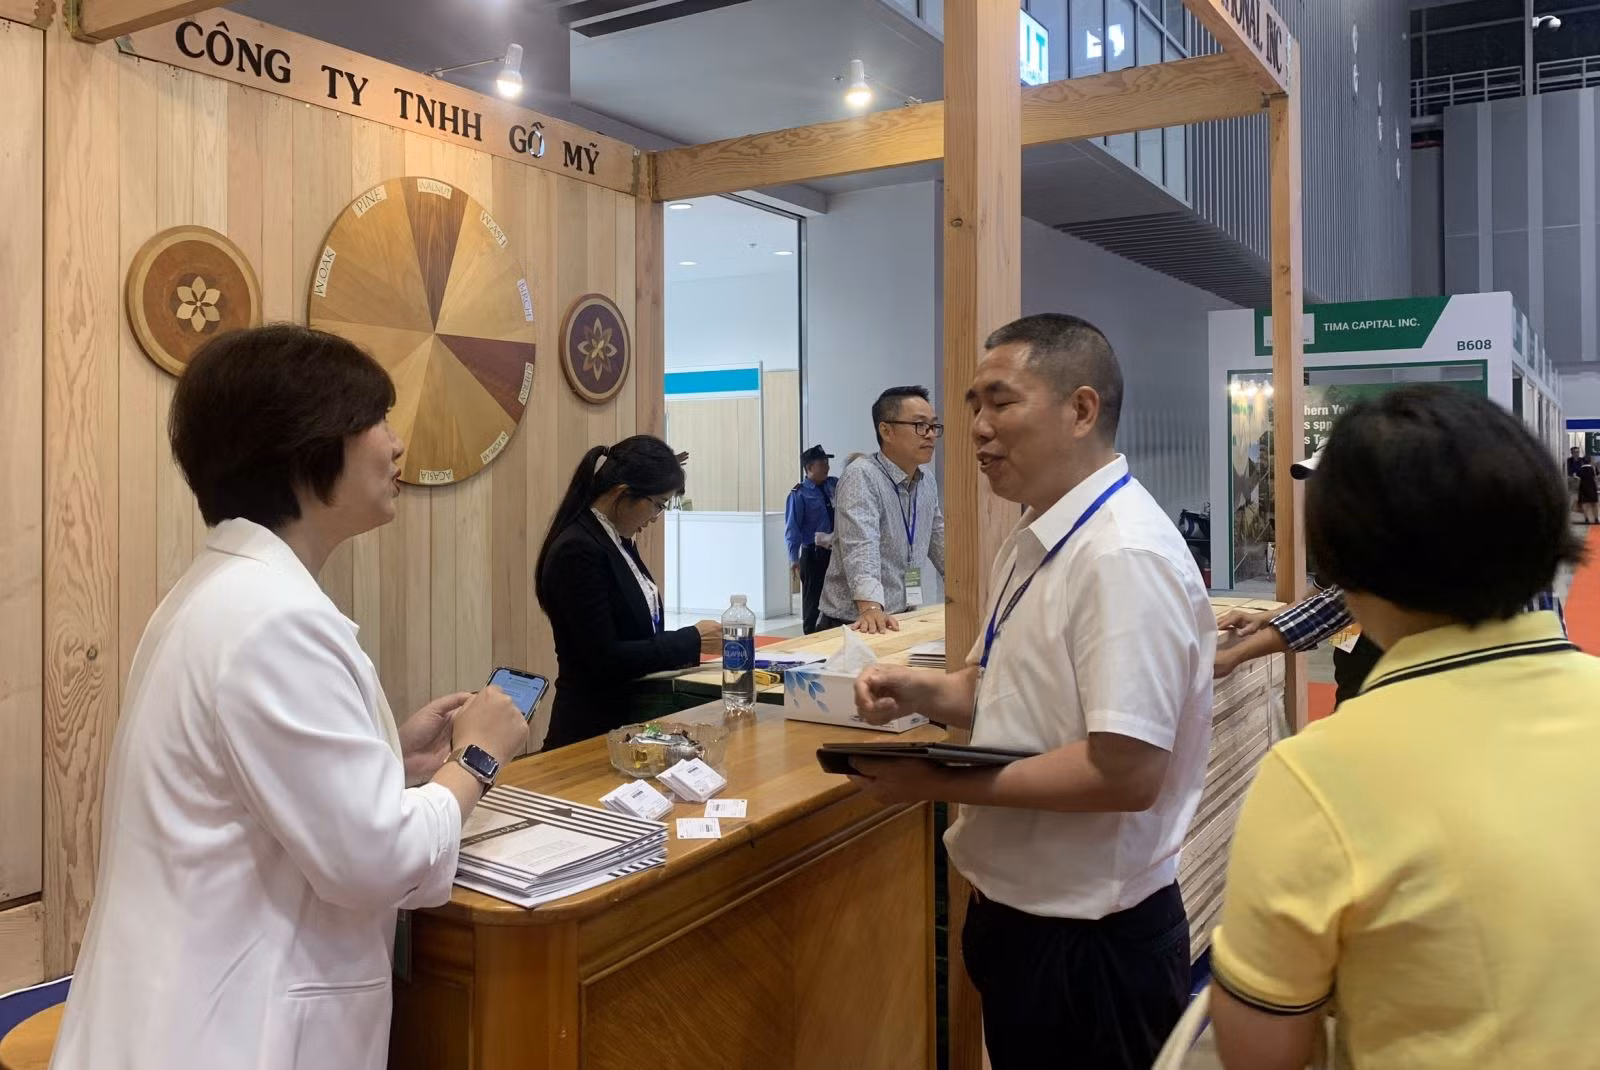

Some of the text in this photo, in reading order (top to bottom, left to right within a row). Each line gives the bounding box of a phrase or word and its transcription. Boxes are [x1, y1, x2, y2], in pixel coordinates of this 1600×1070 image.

[1266, 13, 1282, 74] INC
[175, 21, 291, 83] CÔNG
[321, 65, 368, 106] TY
[394, 87, 482, 142] TNHH
[563, 142, 600, 175] MỸ
[419, 180, 451, 197] WALNUT
[355, 188, 382, 213] PINE
[1323, 317, 1421, 332] TIMA CAPITAL INC.
[1456, 339, 1492, 351] B608
[1303, 405, 1329, 416] hern
